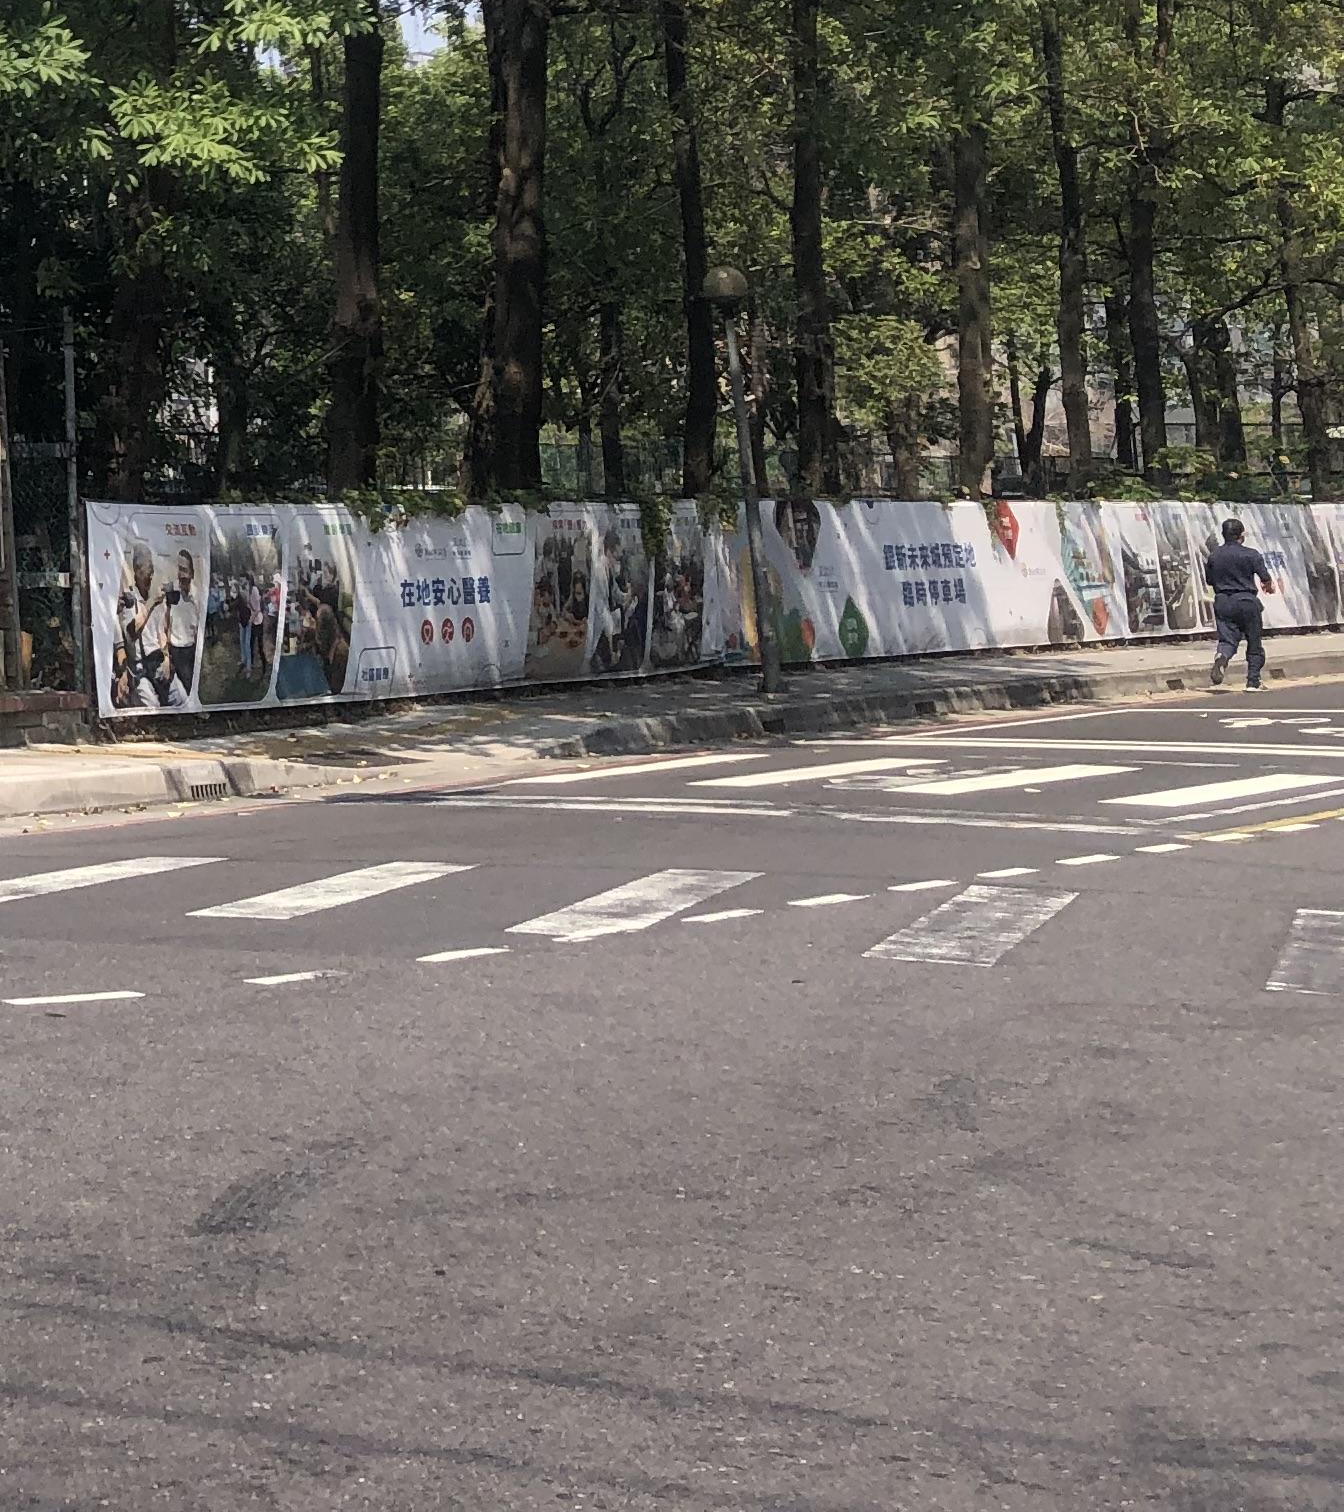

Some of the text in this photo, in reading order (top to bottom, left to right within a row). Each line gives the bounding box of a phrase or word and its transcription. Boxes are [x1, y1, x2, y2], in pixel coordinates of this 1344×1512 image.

[400, 575, 491, 608] 在地安心醫養
